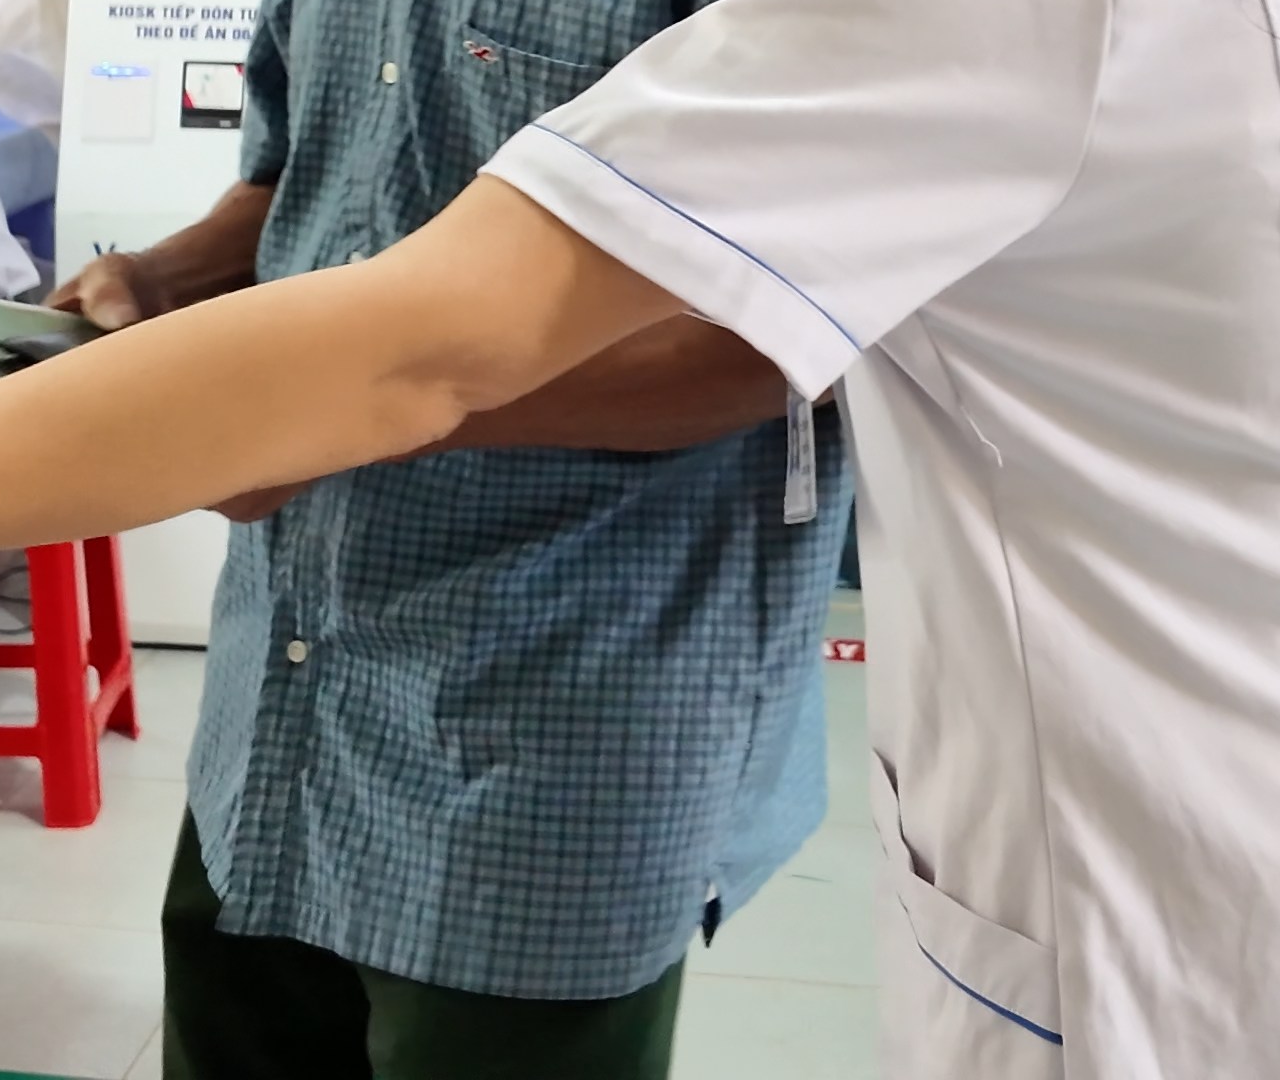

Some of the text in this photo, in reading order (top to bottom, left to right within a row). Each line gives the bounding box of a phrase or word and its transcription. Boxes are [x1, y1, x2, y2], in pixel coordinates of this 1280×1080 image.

[108, 5, 156, 19] KIOSK
[163, 4, 196, 20] TIẾP
[136, 25, 174, 40] THEO
